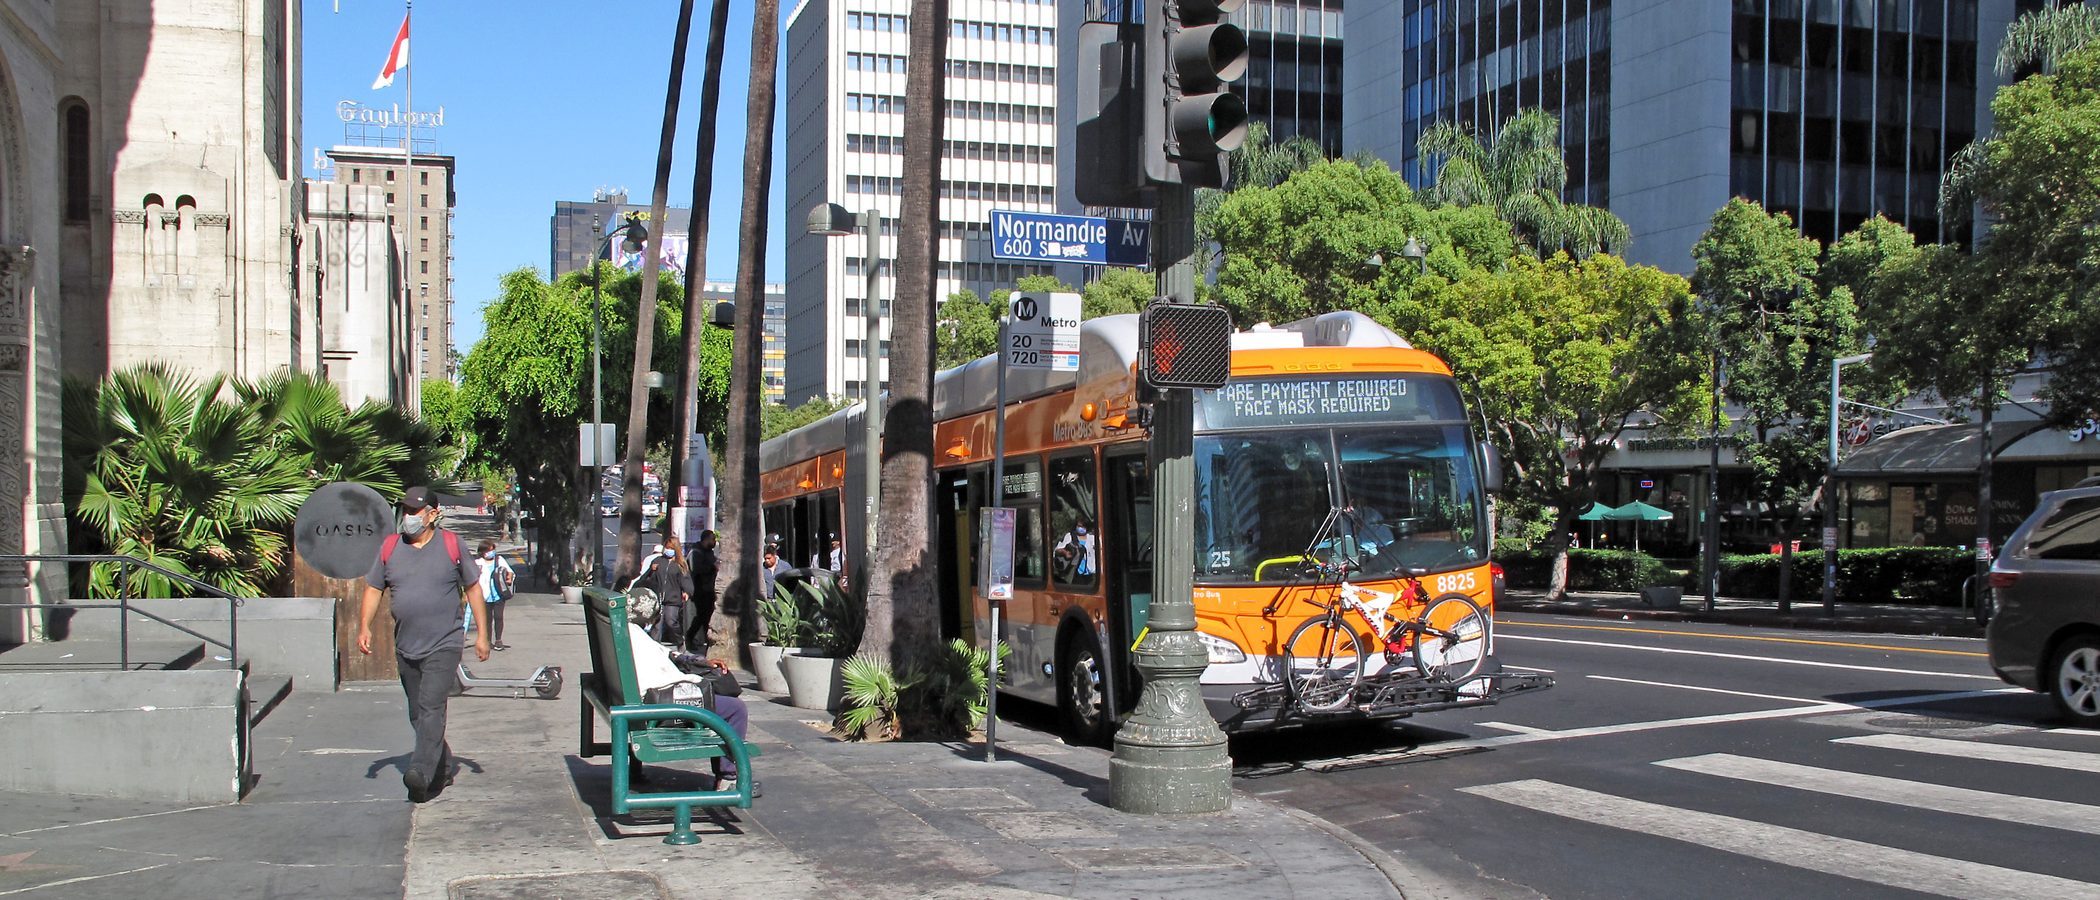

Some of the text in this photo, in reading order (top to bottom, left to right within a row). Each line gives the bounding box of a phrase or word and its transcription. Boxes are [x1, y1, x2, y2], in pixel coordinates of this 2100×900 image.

[336, 100, 445, 128] Gaylord
[998, 213, 1145, 247] Normandie Av
[1003, 238, 1048, 257] 600 S
[1040, 316, 1077, 328] Metro
[1012, 335, 1032, 348] 20
[1011, 351, 1038, 364] 720
[1217, 378, 1407, 401] FARE PAYMENT REQUIRED
[1234, 396, 1391, 417] FACE MASK REQUIRED
[1053, 419, 1093, 442] Metro Bus
[316, 524, 375, 537] OASIS
[1211, 550, 1231, 568] 25
[1437, 572, 1476, 593] 8825
[1193, 591, 1205, 599] tro
